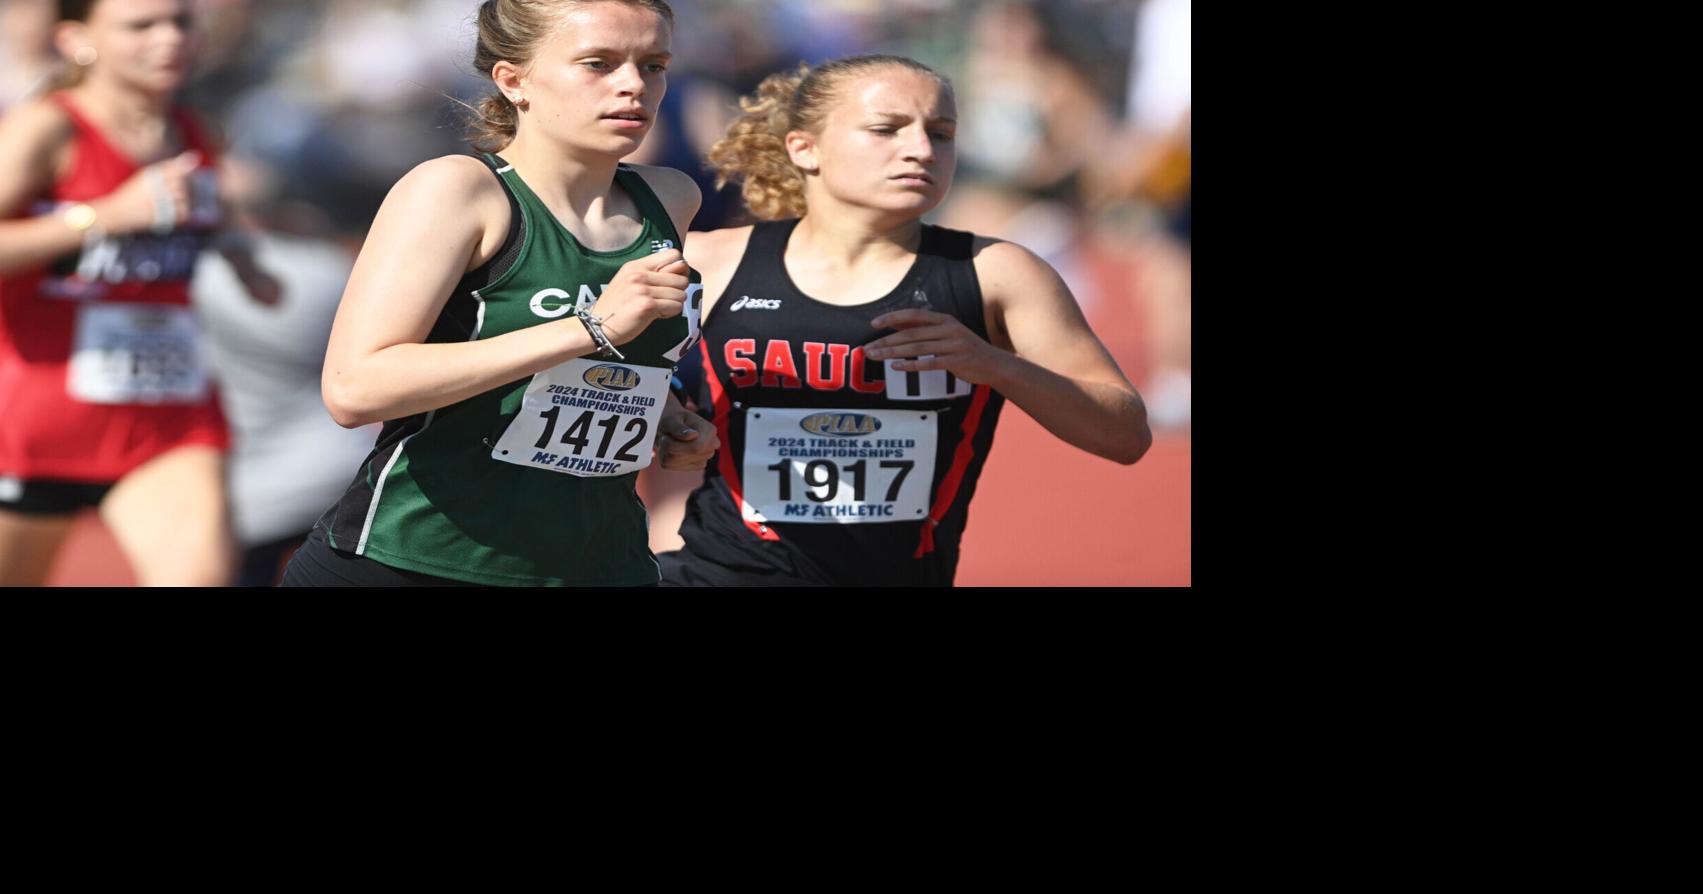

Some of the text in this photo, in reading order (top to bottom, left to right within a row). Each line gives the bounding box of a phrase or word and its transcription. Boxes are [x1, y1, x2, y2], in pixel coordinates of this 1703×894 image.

[529, 284, 609, 318] CA
[744, 297, 782, 310] asics
[589, 366, 637, 388] PIAA
[546, 384, 656, 407] 2024 TRACK & FIELD
[551, 395, 647, 417] CHAMPIONSHIPS
[810, 414, 876, 433] PIAA
[534, 405, 648, 463] 1412
[768, 437, 916, 449] 2024 TRACK & FIELD
[778, 447, 904, 459] CHAMPIONSHIPS
[556, 456, 622, 474] ATHLETIC
[767, 458, 915, 503] 1917
[812, 504, 894, 517] ATHLETIC
